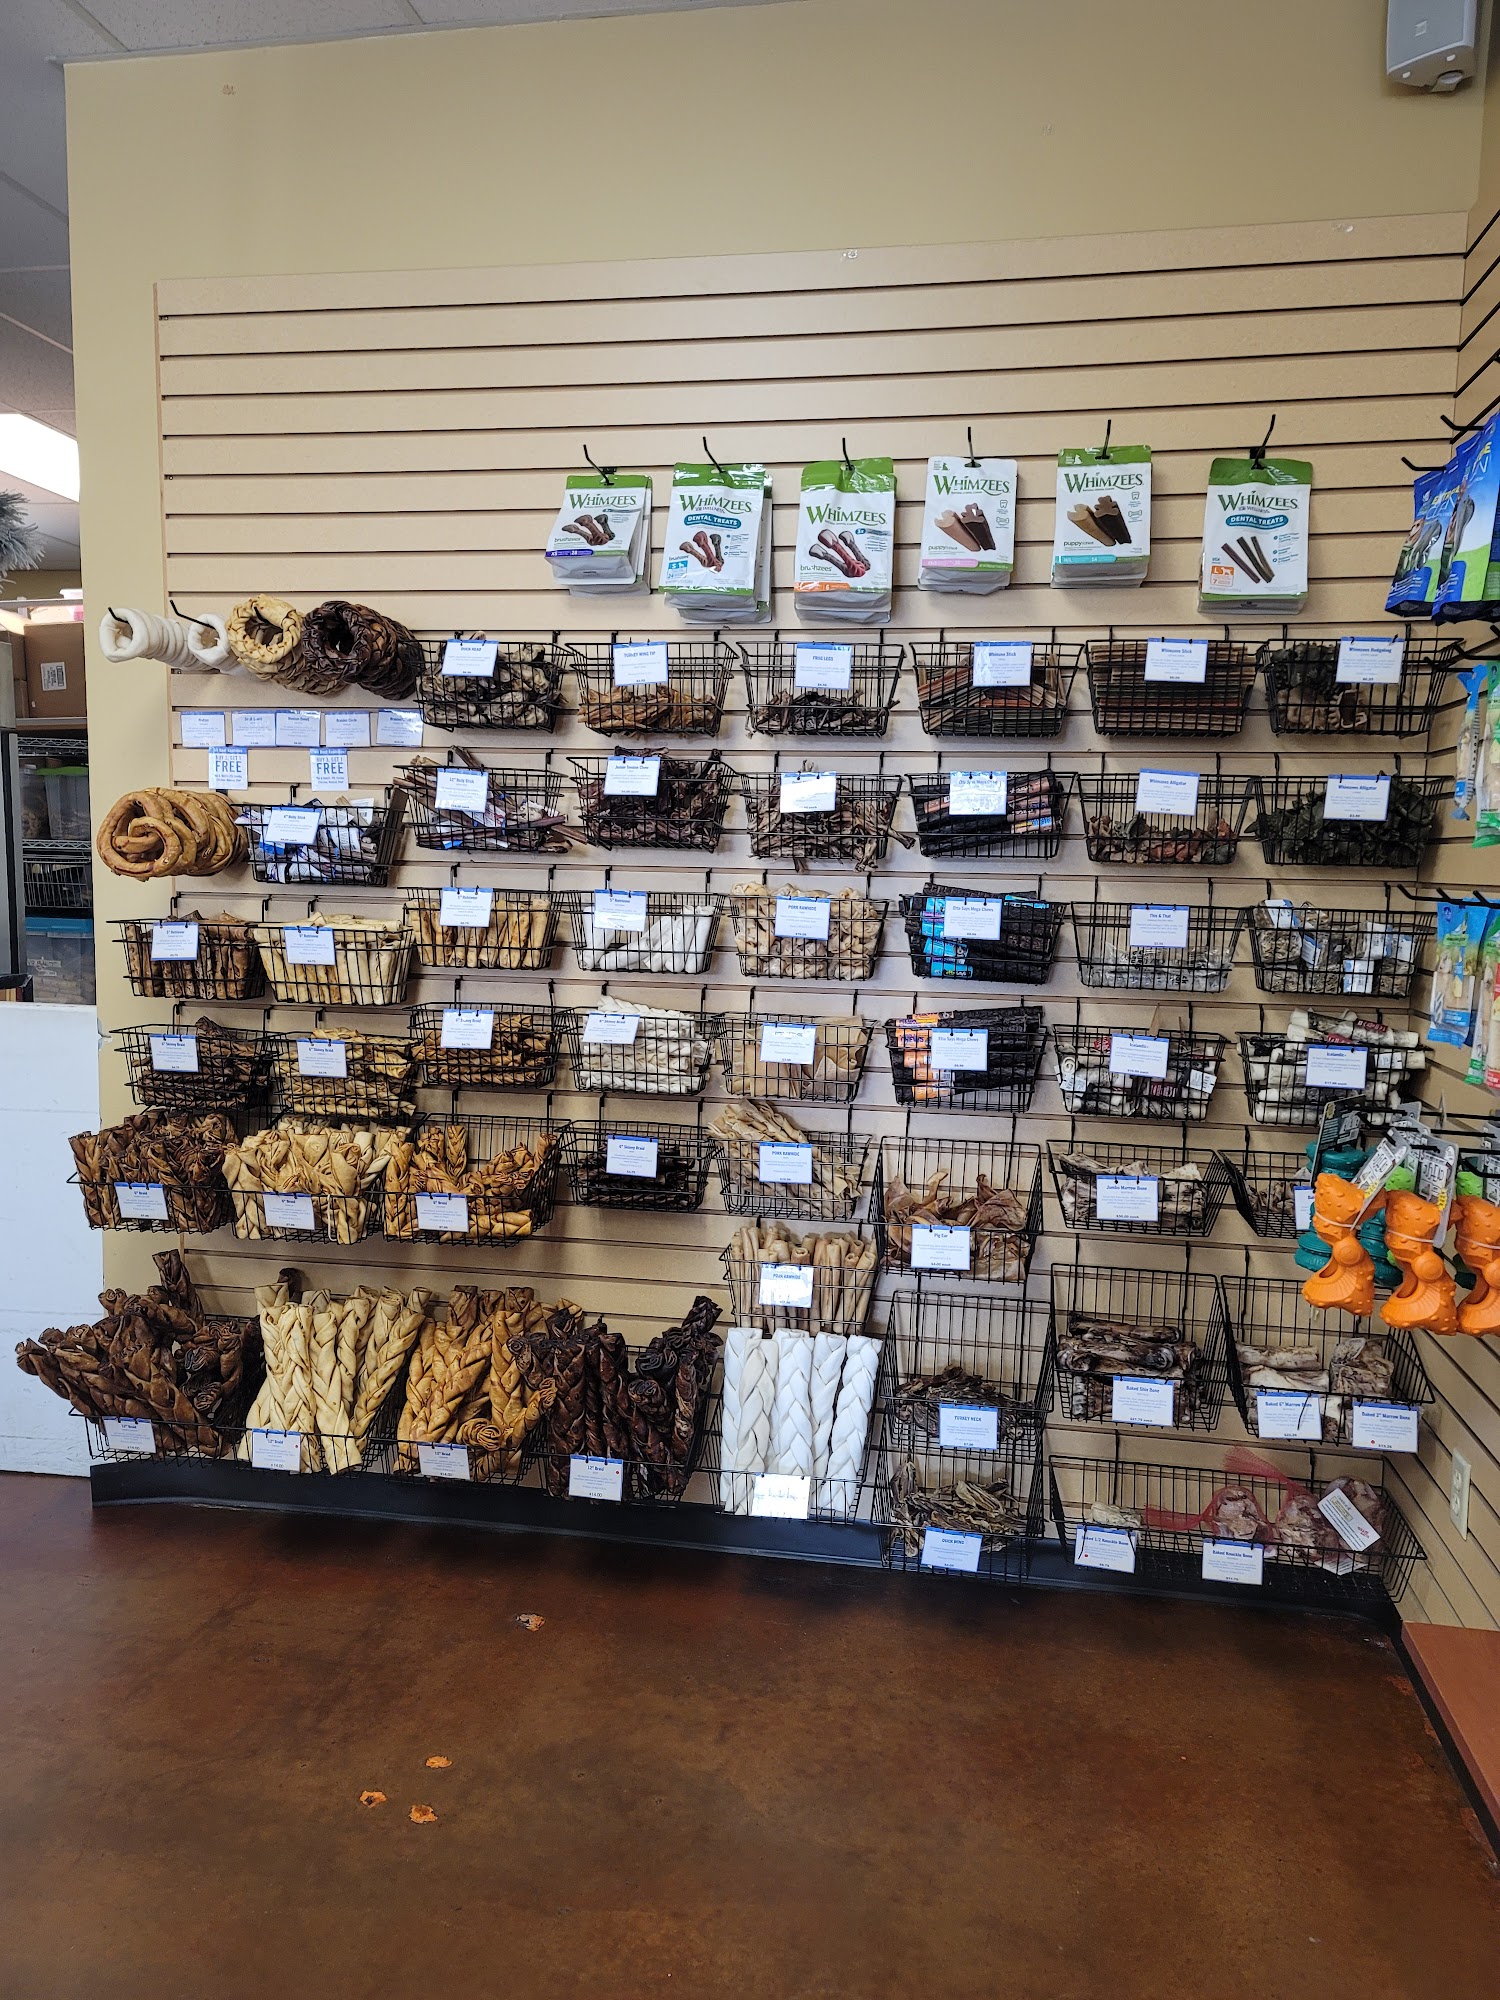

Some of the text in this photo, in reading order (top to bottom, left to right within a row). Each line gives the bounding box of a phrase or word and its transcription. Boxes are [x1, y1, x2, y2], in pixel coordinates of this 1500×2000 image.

[933, 475, 1010, 496] WHIMZEES
[1064, 472, 1143, 493] WHIMZEES
[569, 493, 637, 509] WHIMZEES
[679, 494, 752, 513] WHIMZEES
[1218, 490, 1299, 511] WHIMZEES
[713, 517, 738, 525] TREATS
[806, 503, 886, 526] WHIMZEES
[1230, 516, 1285, 525] DENTAL TREATS
[215, 760, 242, 772] FREE
[316, 762, 344, 774] FREE
